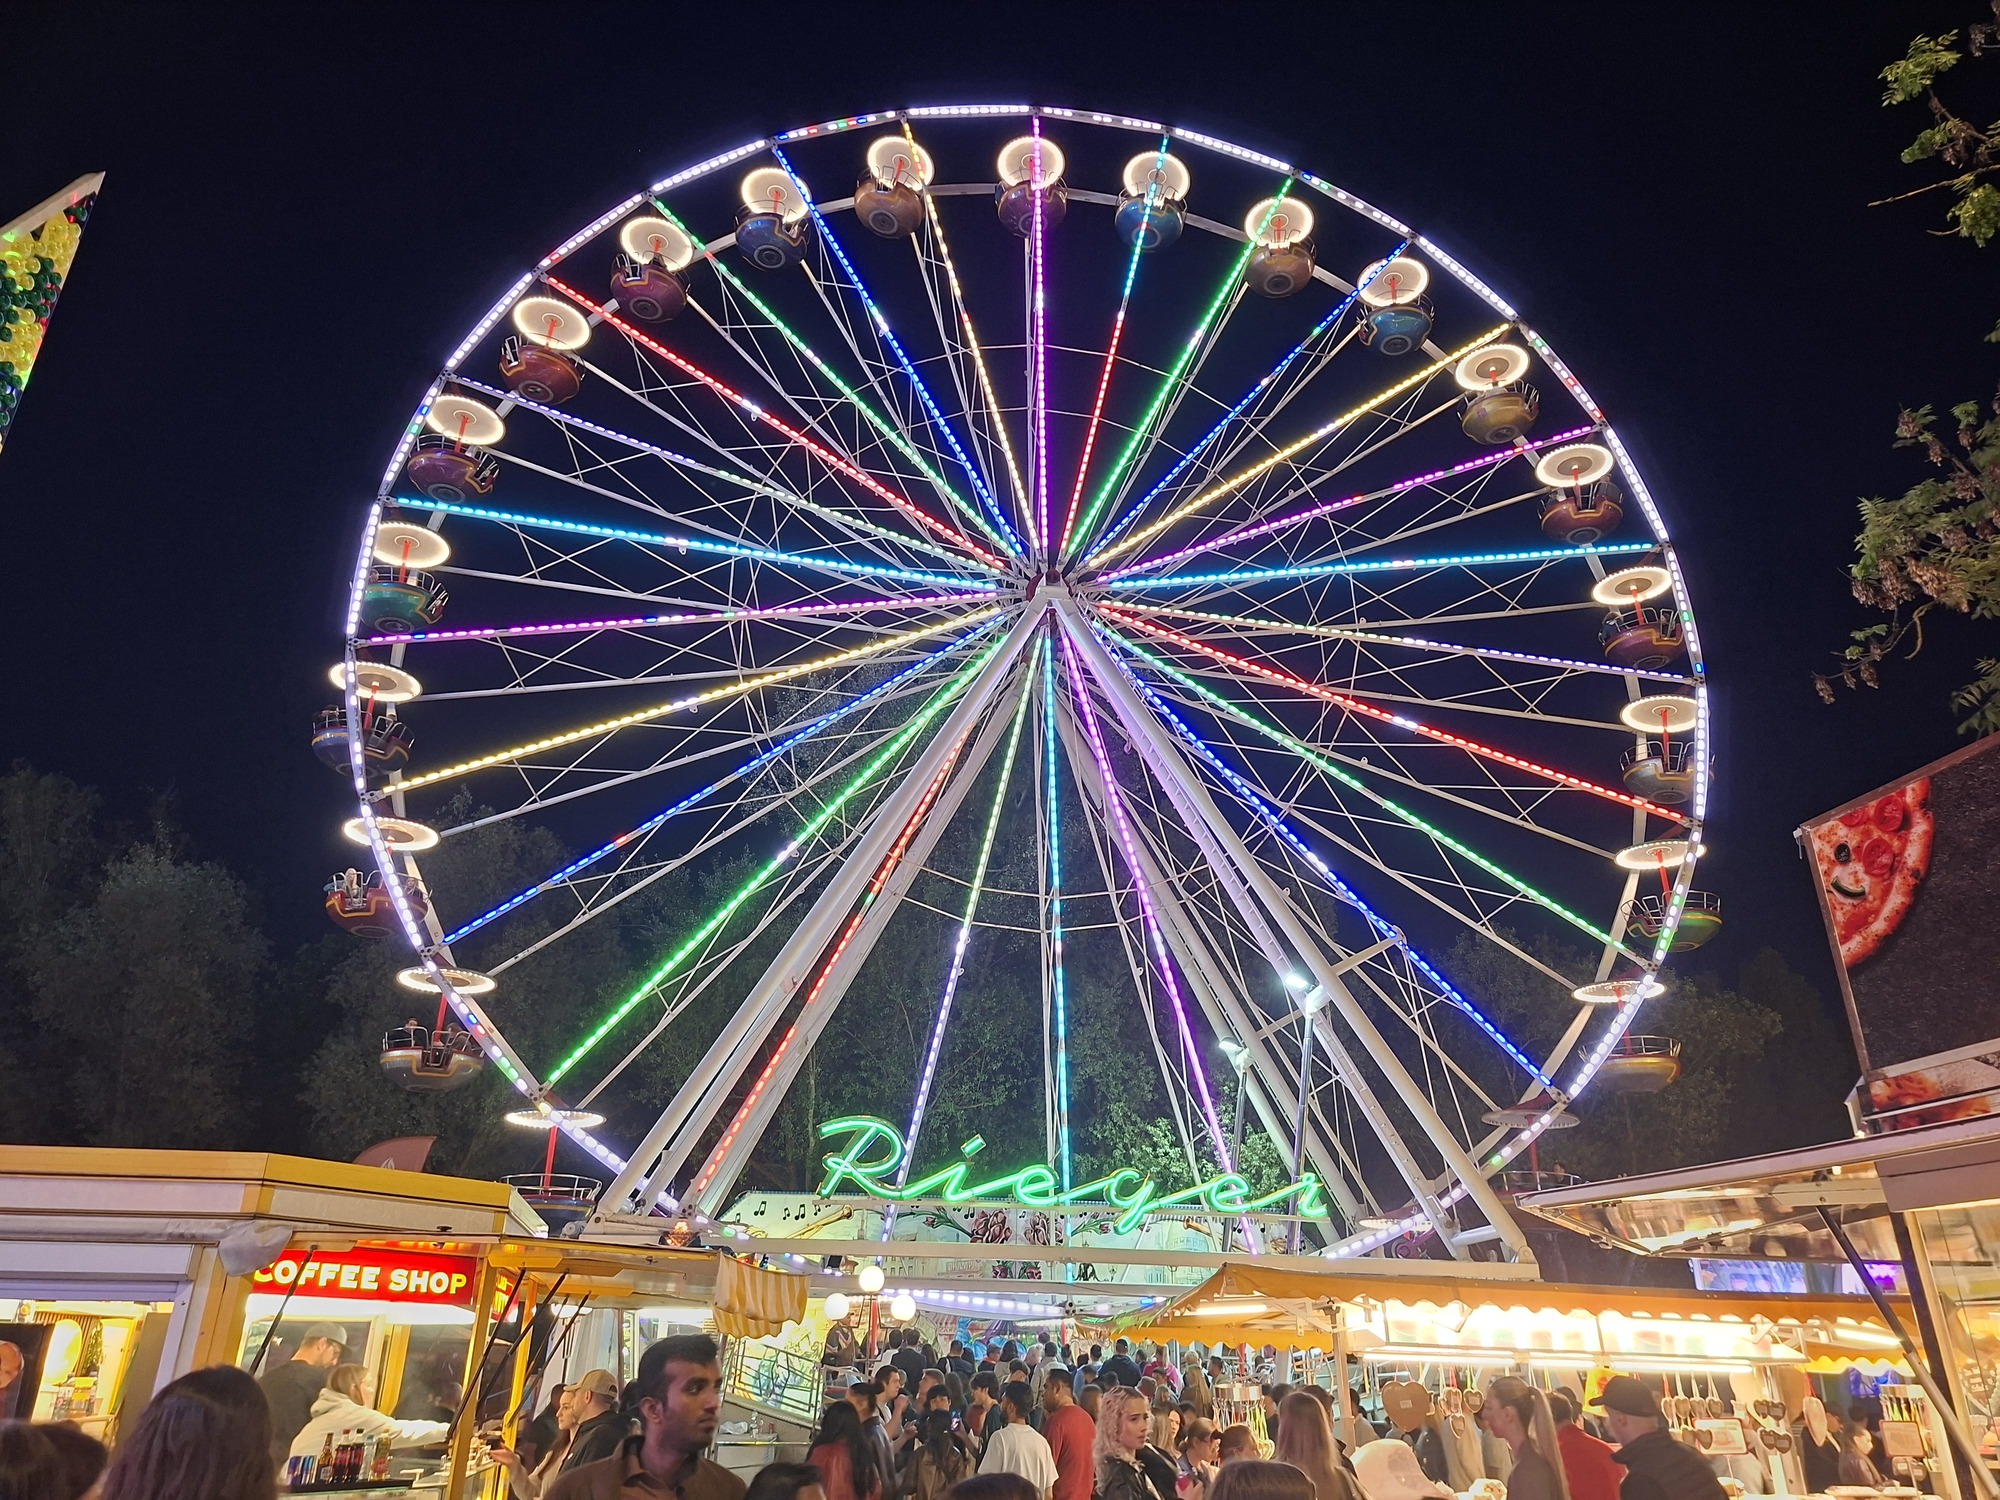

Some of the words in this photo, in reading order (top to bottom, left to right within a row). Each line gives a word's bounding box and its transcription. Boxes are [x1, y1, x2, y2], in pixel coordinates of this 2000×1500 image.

[815, 1115, 1329, 1236] Rieger
[253, 1259, 381, 1291] COFFEE
[388, 1268, 467, 1294] SHOP
